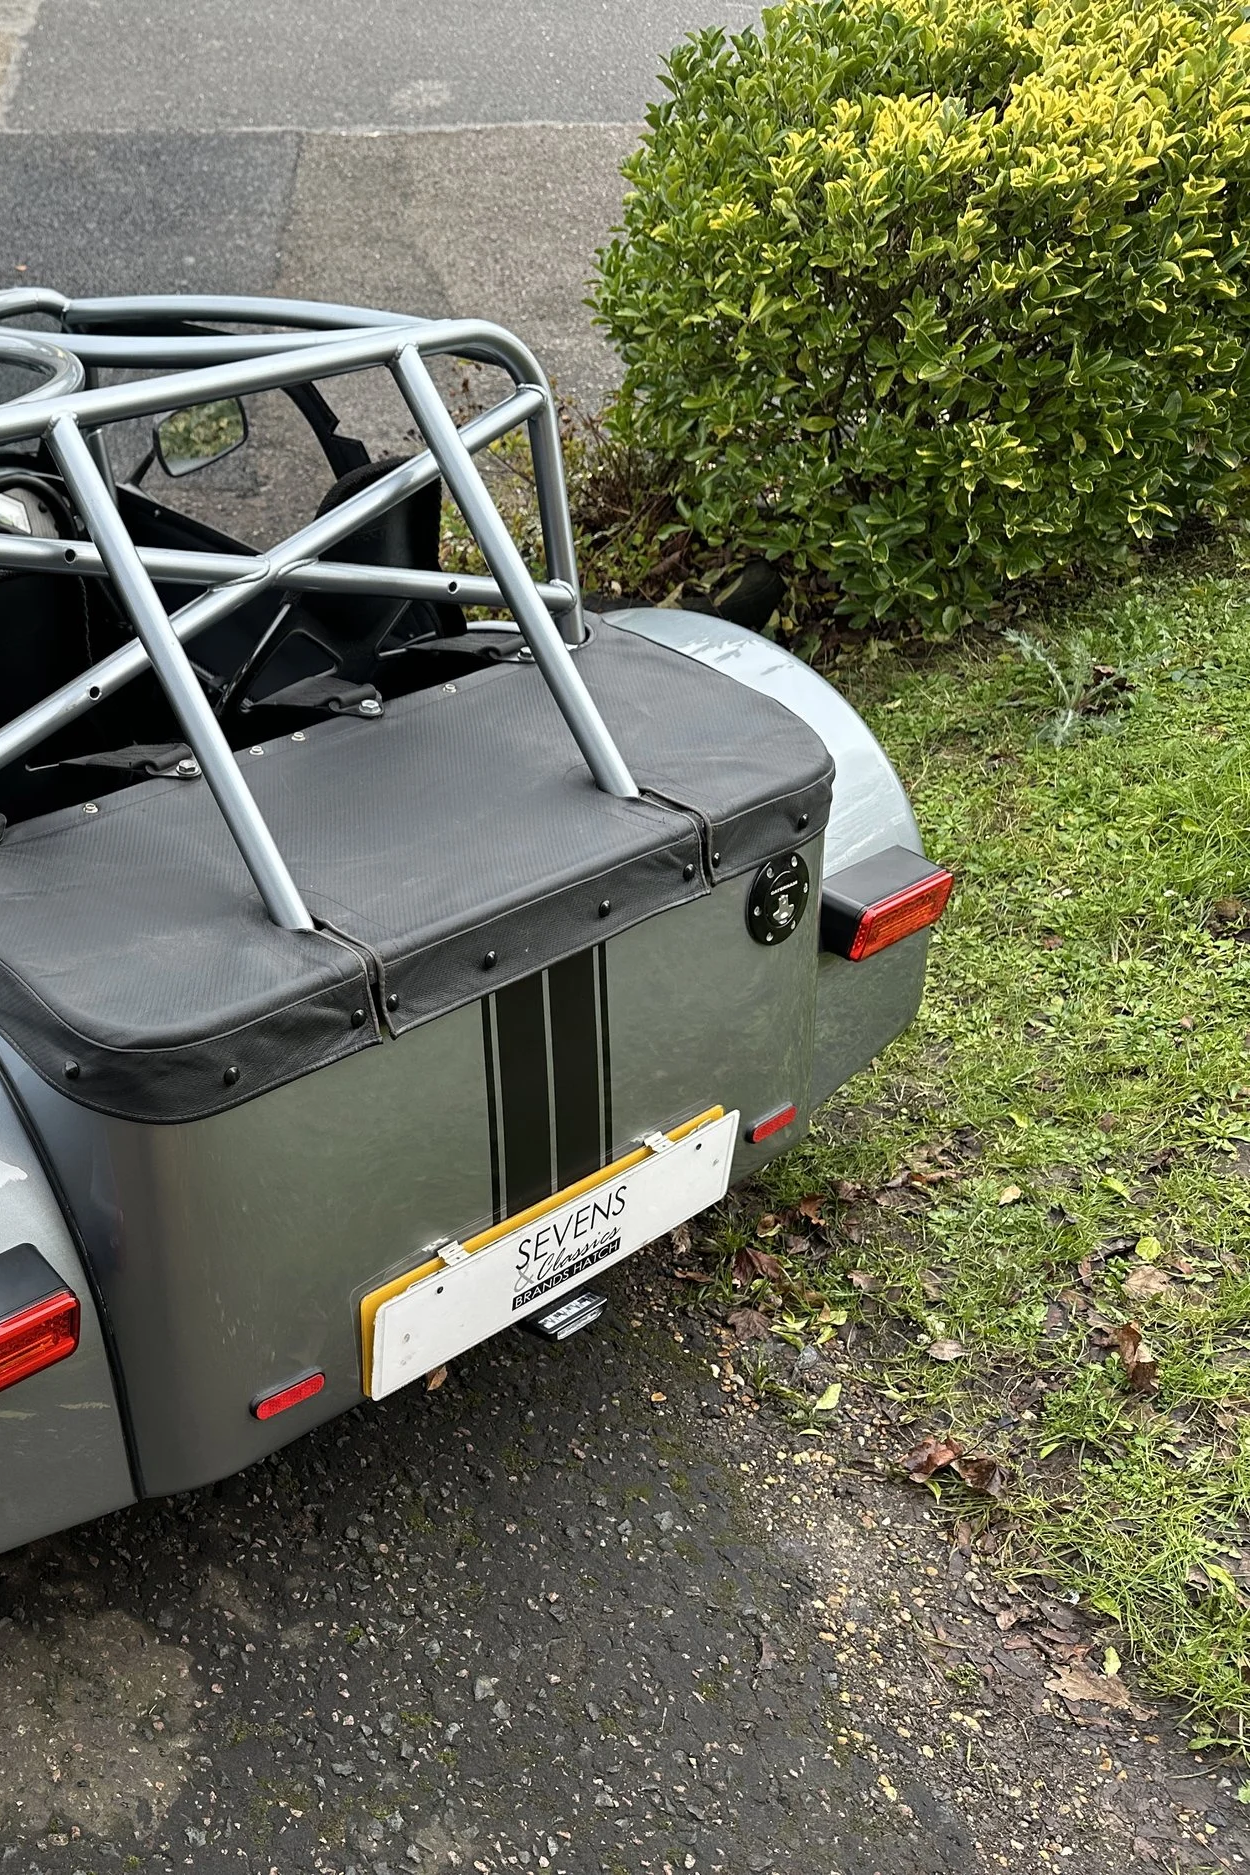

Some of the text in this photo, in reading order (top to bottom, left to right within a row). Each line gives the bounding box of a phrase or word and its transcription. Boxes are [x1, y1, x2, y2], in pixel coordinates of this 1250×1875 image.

[513, 1226, 622, 1293] & Classics
[515, 1185, 627, 1271] SEVENS
[514, 1240, 619, 1308] BRANDS HATCH
